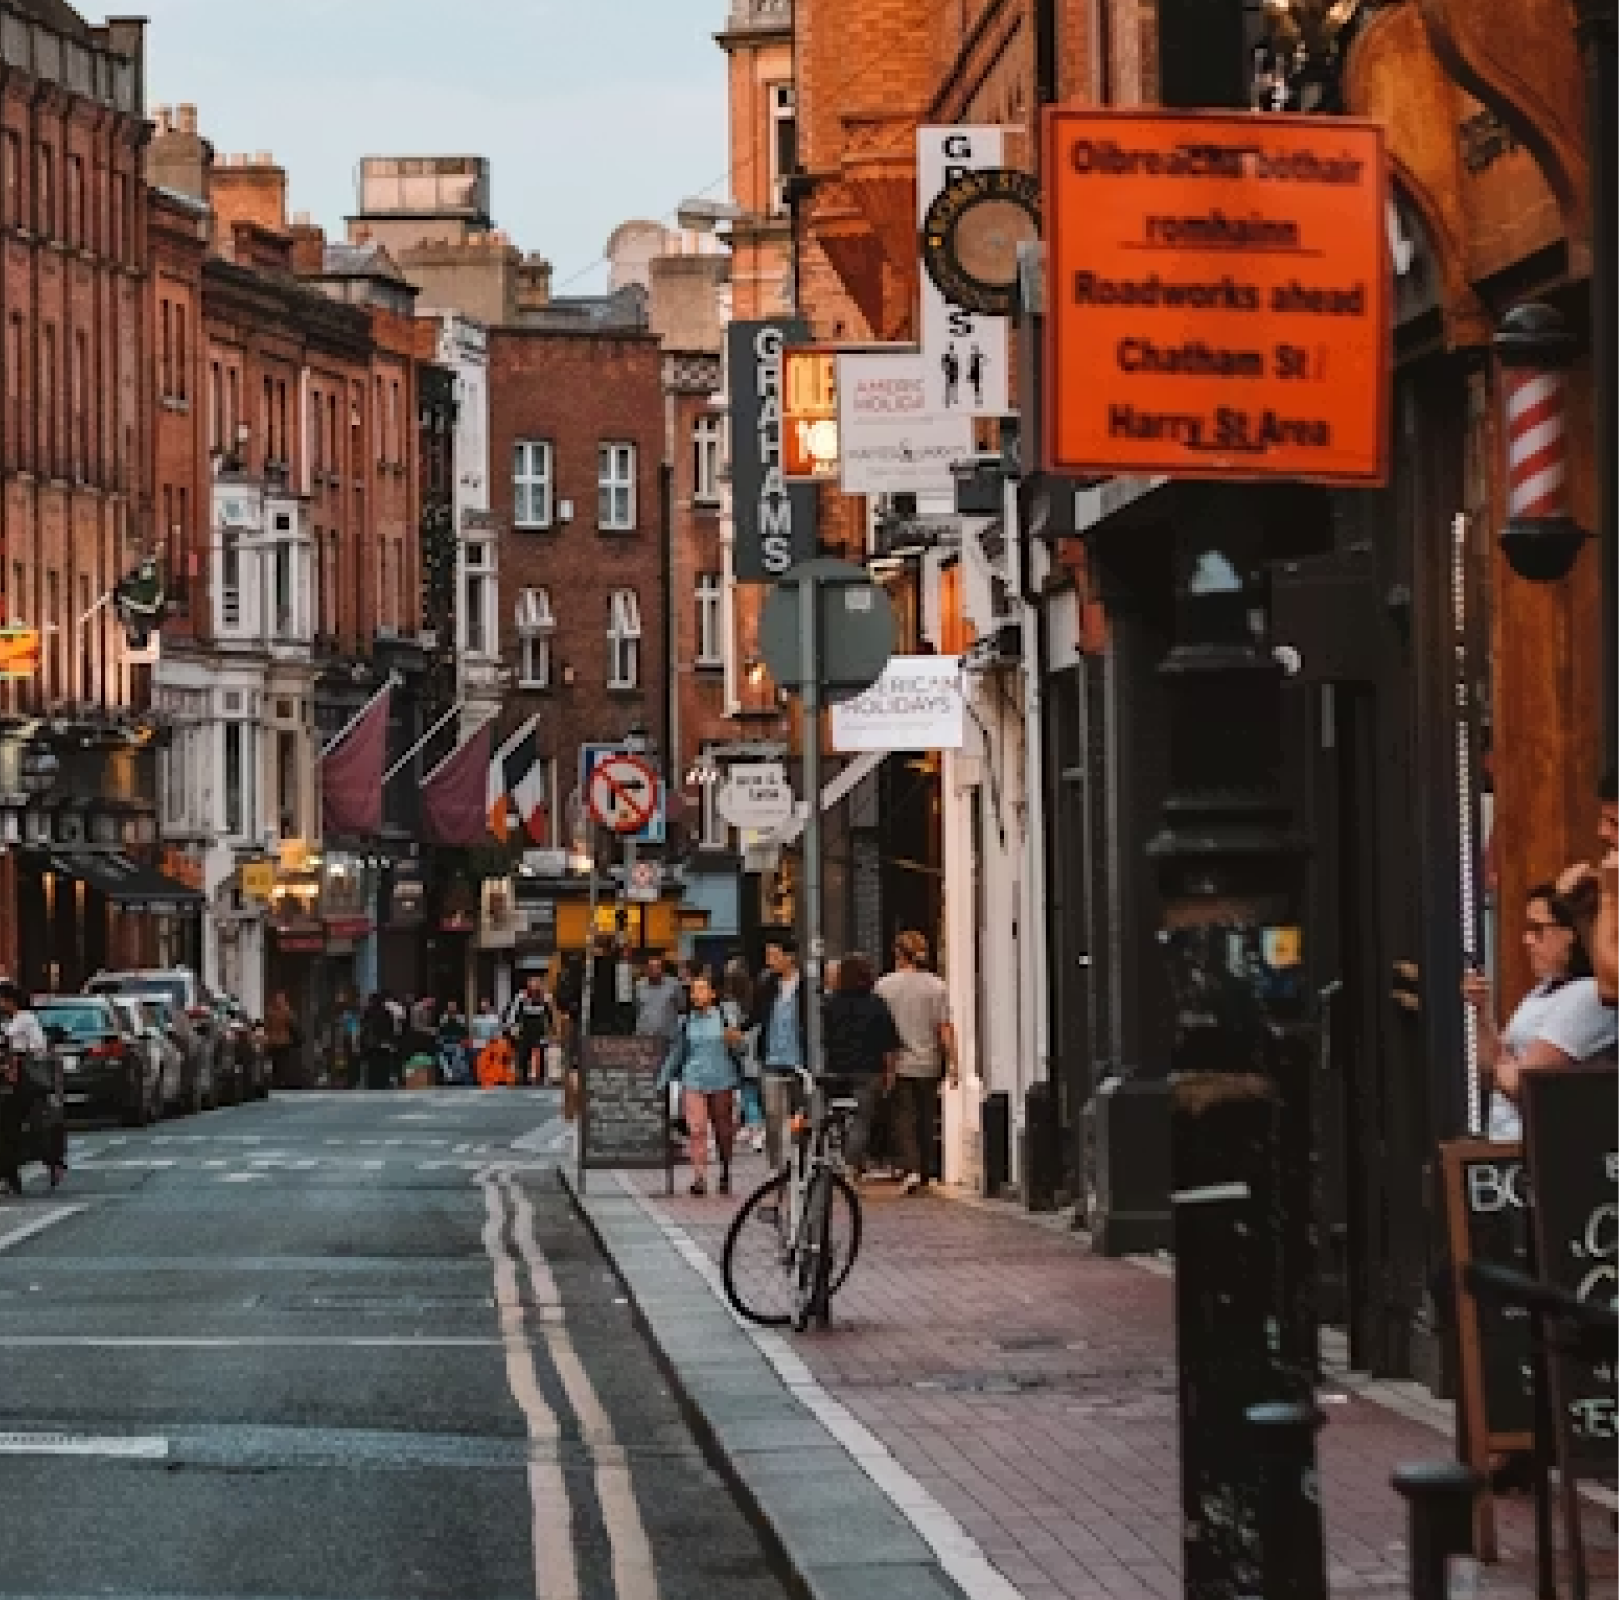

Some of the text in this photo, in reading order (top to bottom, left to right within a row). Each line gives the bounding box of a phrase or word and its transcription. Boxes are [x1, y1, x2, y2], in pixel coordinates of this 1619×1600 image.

[1074, 271, 1366, 316] Roadworks ahead
[1117, 338, 1264, 377] Chatham
[1274, 343, 1308, 380] St
[1108, 403, 1203, 447] Harry
[1259, 410, 1331, 447] Area
